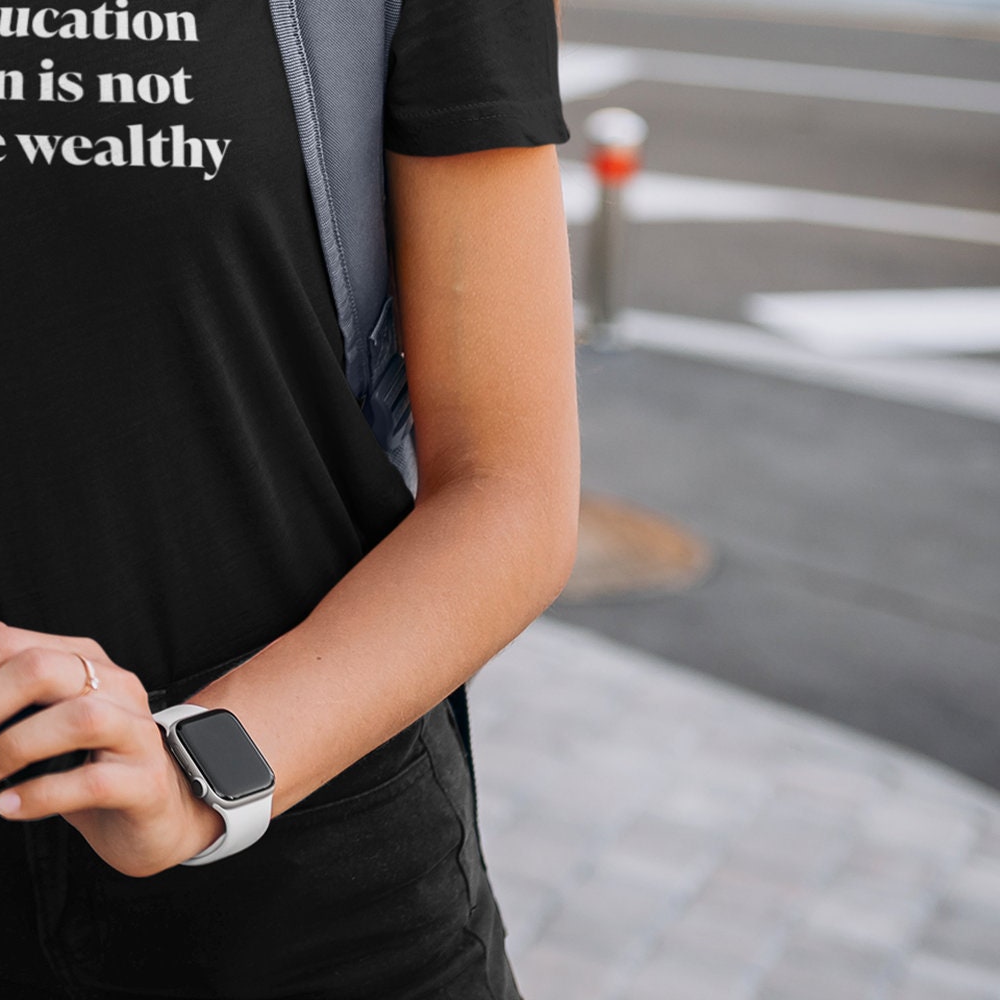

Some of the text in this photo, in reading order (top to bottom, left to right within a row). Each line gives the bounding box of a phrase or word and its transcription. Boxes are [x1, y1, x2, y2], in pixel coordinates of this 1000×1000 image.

[38, 58, 84, 103] is
[97, 66, 194, 105] not
[15, 123, 232, 181] wealthy
